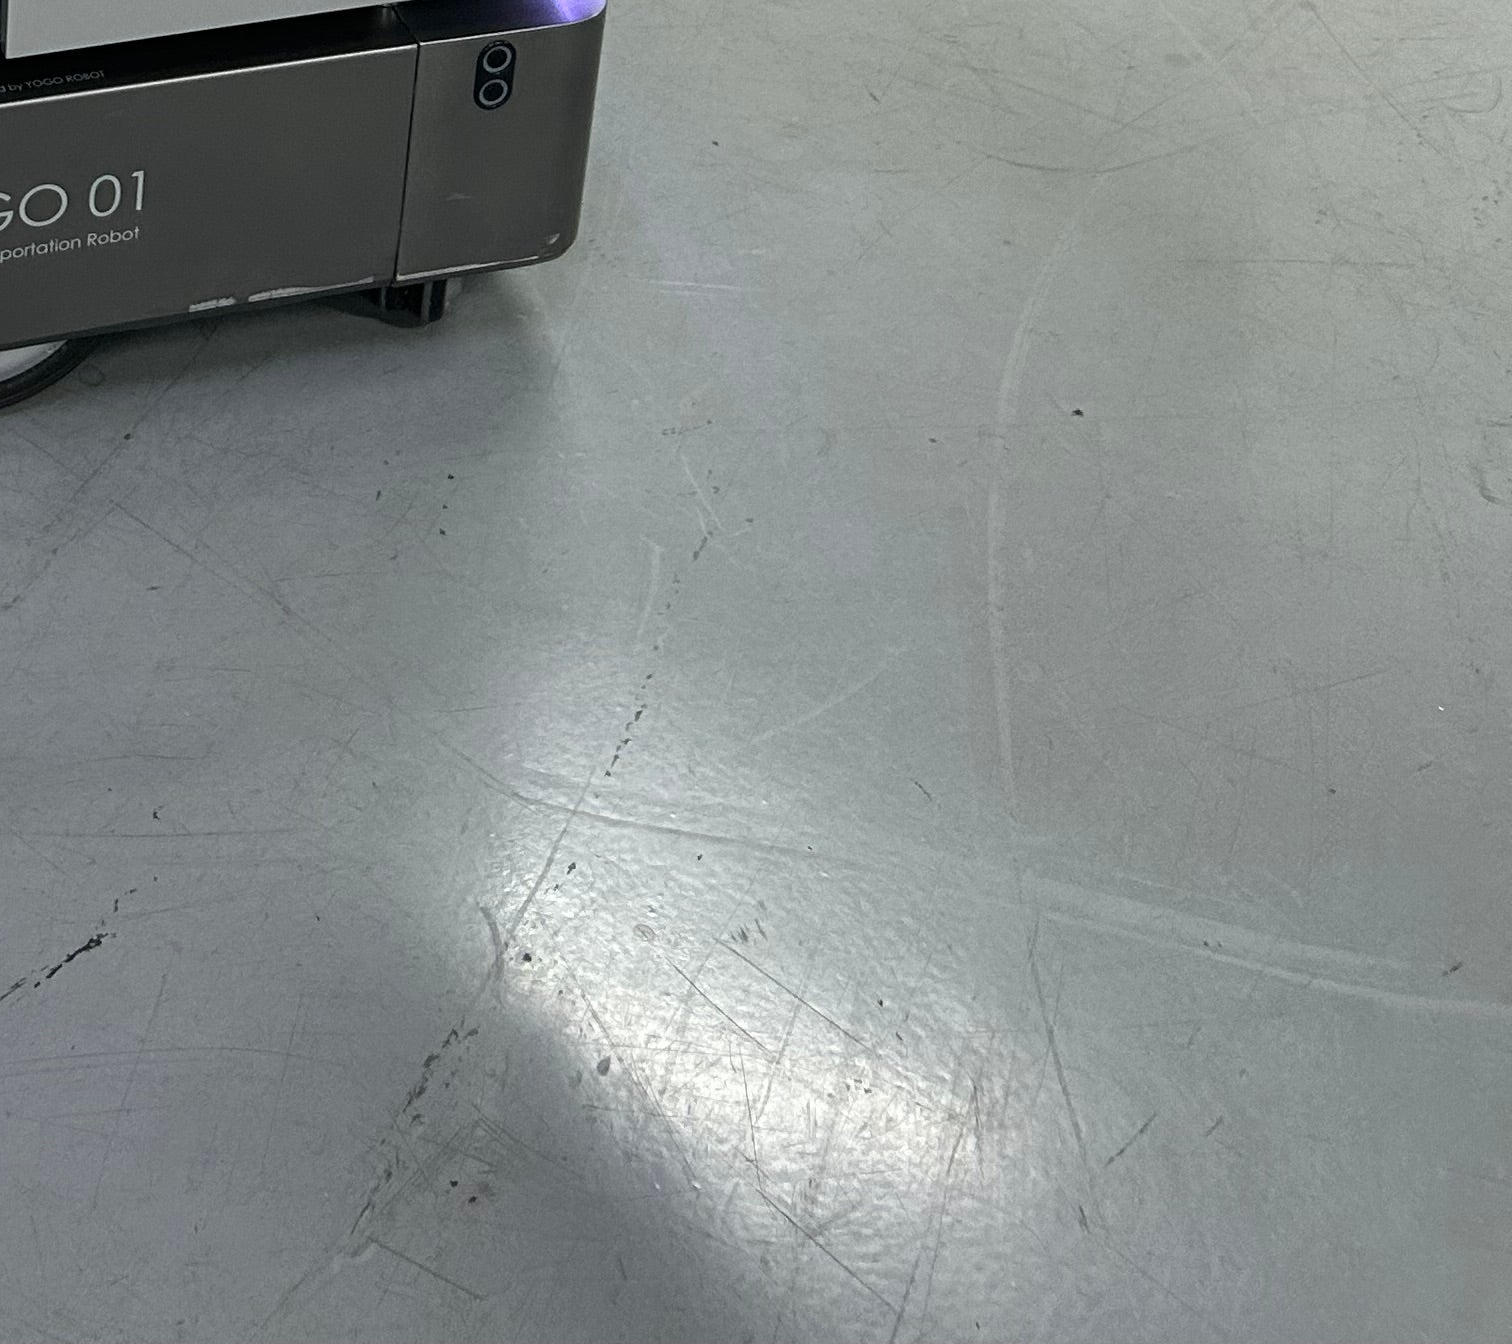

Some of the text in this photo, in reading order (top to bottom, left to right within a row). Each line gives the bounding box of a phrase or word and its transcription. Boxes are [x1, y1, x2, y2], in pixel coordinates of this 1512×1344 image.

[8, 82, 24, 94] by
[24, 76, 64, 88] YOGO
[66, 69, 106, 83] ROBOT
[88, 170, 145, 218] 01
[86, 226, 140, 248] Robot
